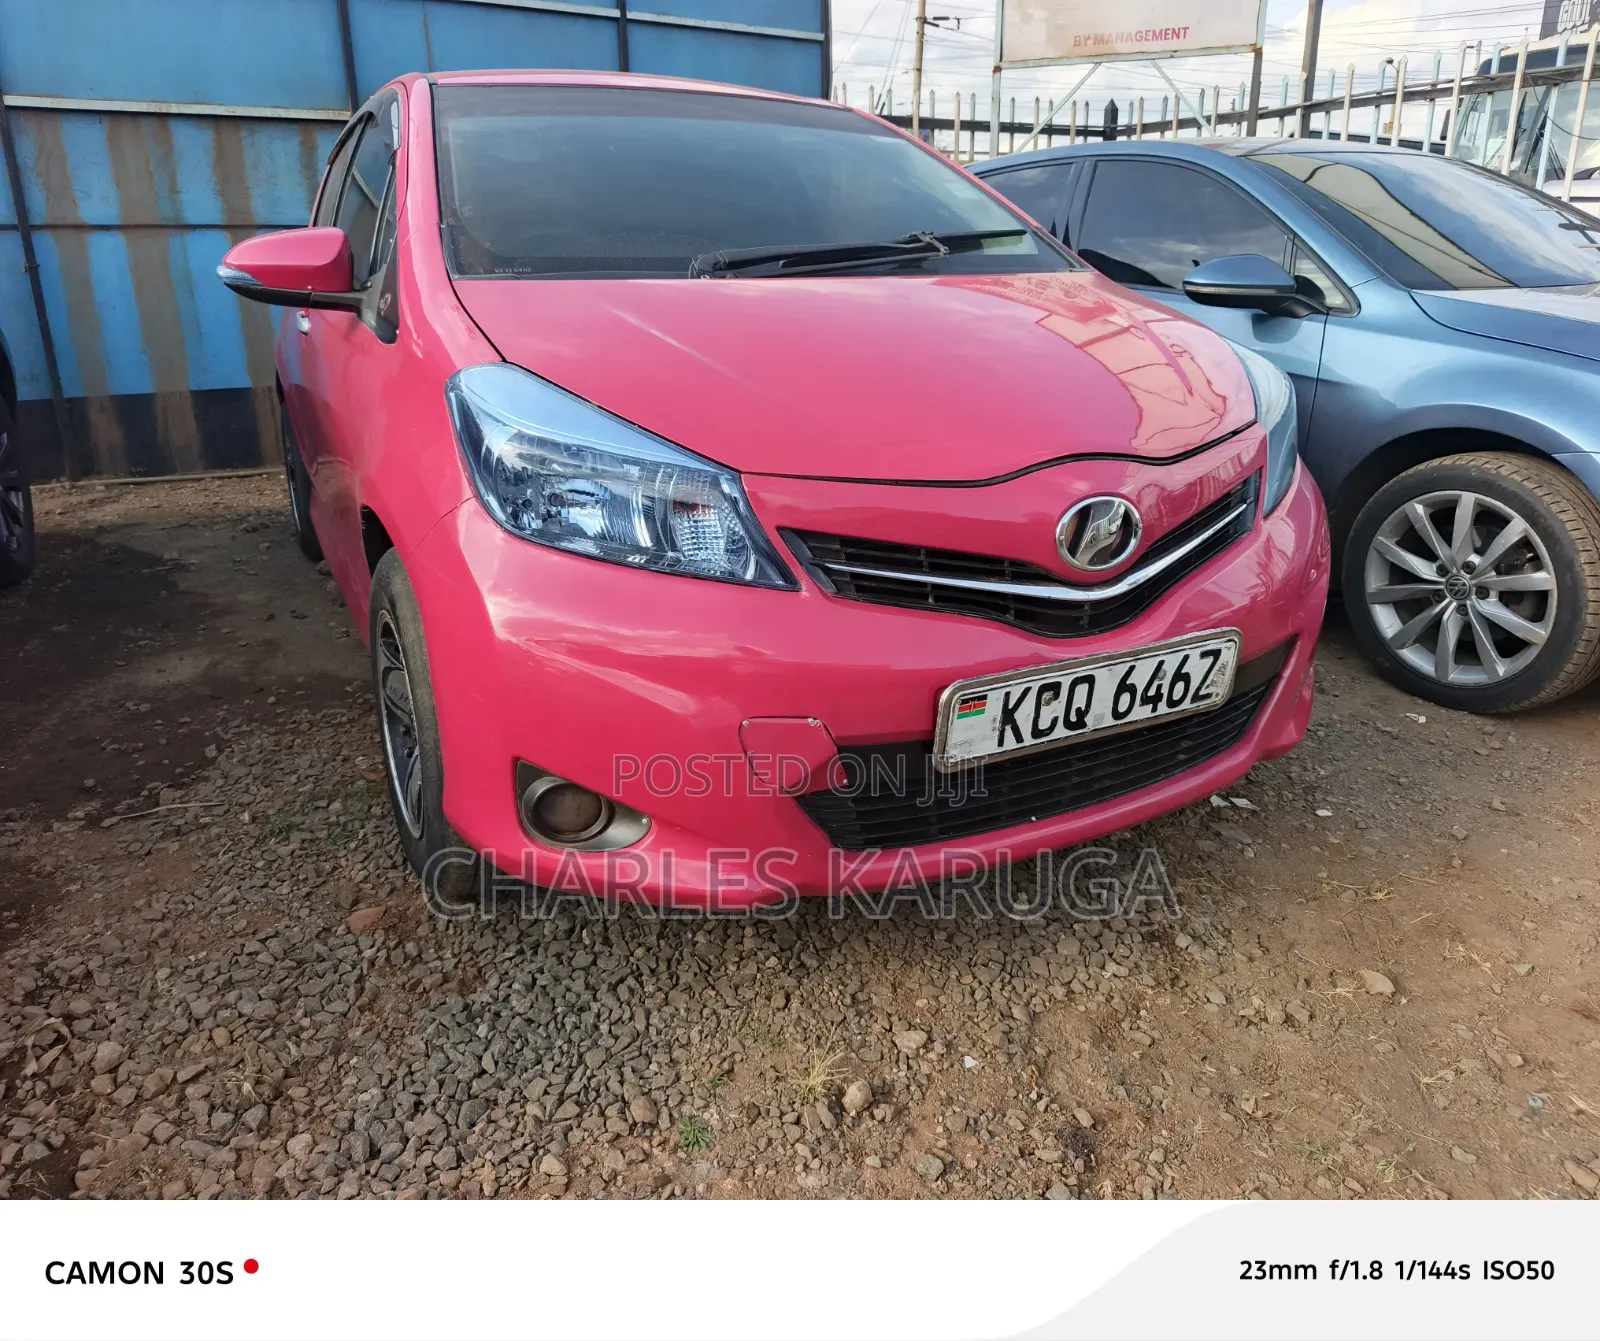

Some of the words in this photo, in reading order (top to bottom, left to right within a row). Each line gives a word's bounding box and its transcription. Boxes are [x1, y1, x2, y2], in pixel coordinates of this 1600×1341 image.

[1073, 34, 1092, 48] BY
[1092, 26, 1190, 46] MANAGEMENT
[997, 673, 1096, 748] KCQ
[1110, 648, 1223, 721] 646Z
